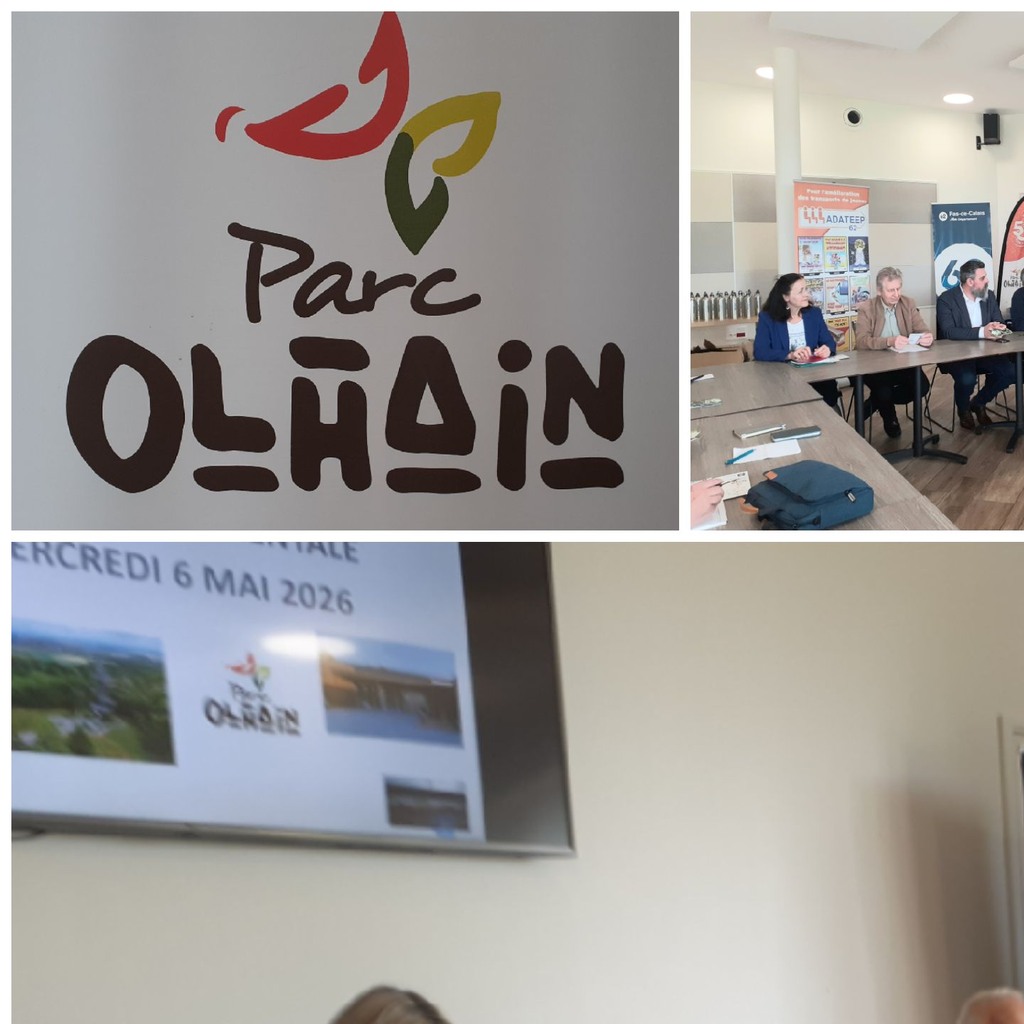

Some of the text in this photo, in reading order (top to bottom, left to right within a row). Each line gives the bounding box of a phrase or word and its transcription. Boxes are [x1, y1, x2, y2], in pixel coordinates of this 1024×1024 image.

[826, 215, 866, 224] ADATEEP
[227, 222, 481, 323] Parc
[173, 560, 194, 589] 6
[203, 565, 270, 601] MAI
[280, 579, 354, 615] 2026
